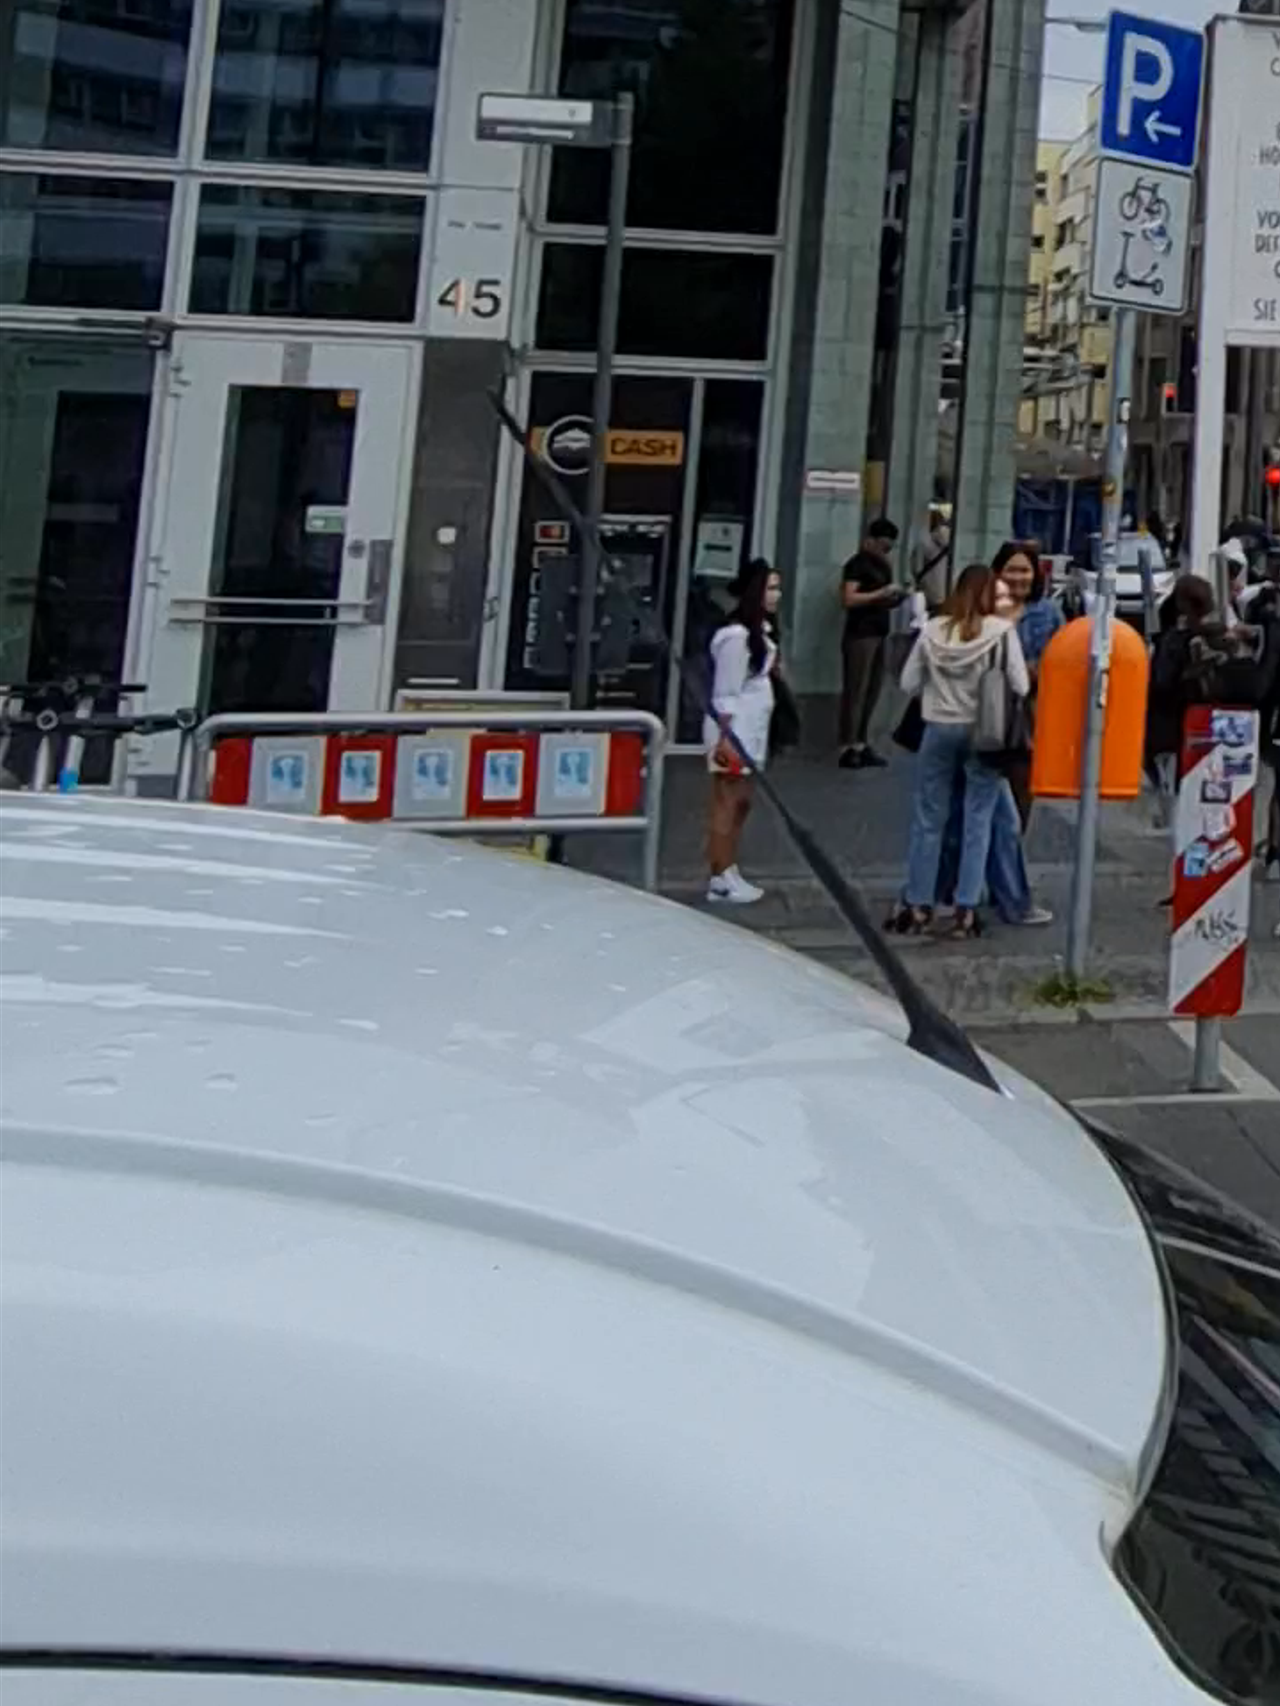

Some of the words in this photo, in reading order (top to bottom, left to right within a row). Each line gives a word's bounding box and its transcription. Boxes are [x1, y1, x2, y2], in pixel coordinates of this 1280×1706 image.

[1116, 32, 1175, 137] P
[437, 278, 501, 319] 45
[1253, 297, 1277, 321] SIE
[609, 437, 677, 458] CASH
